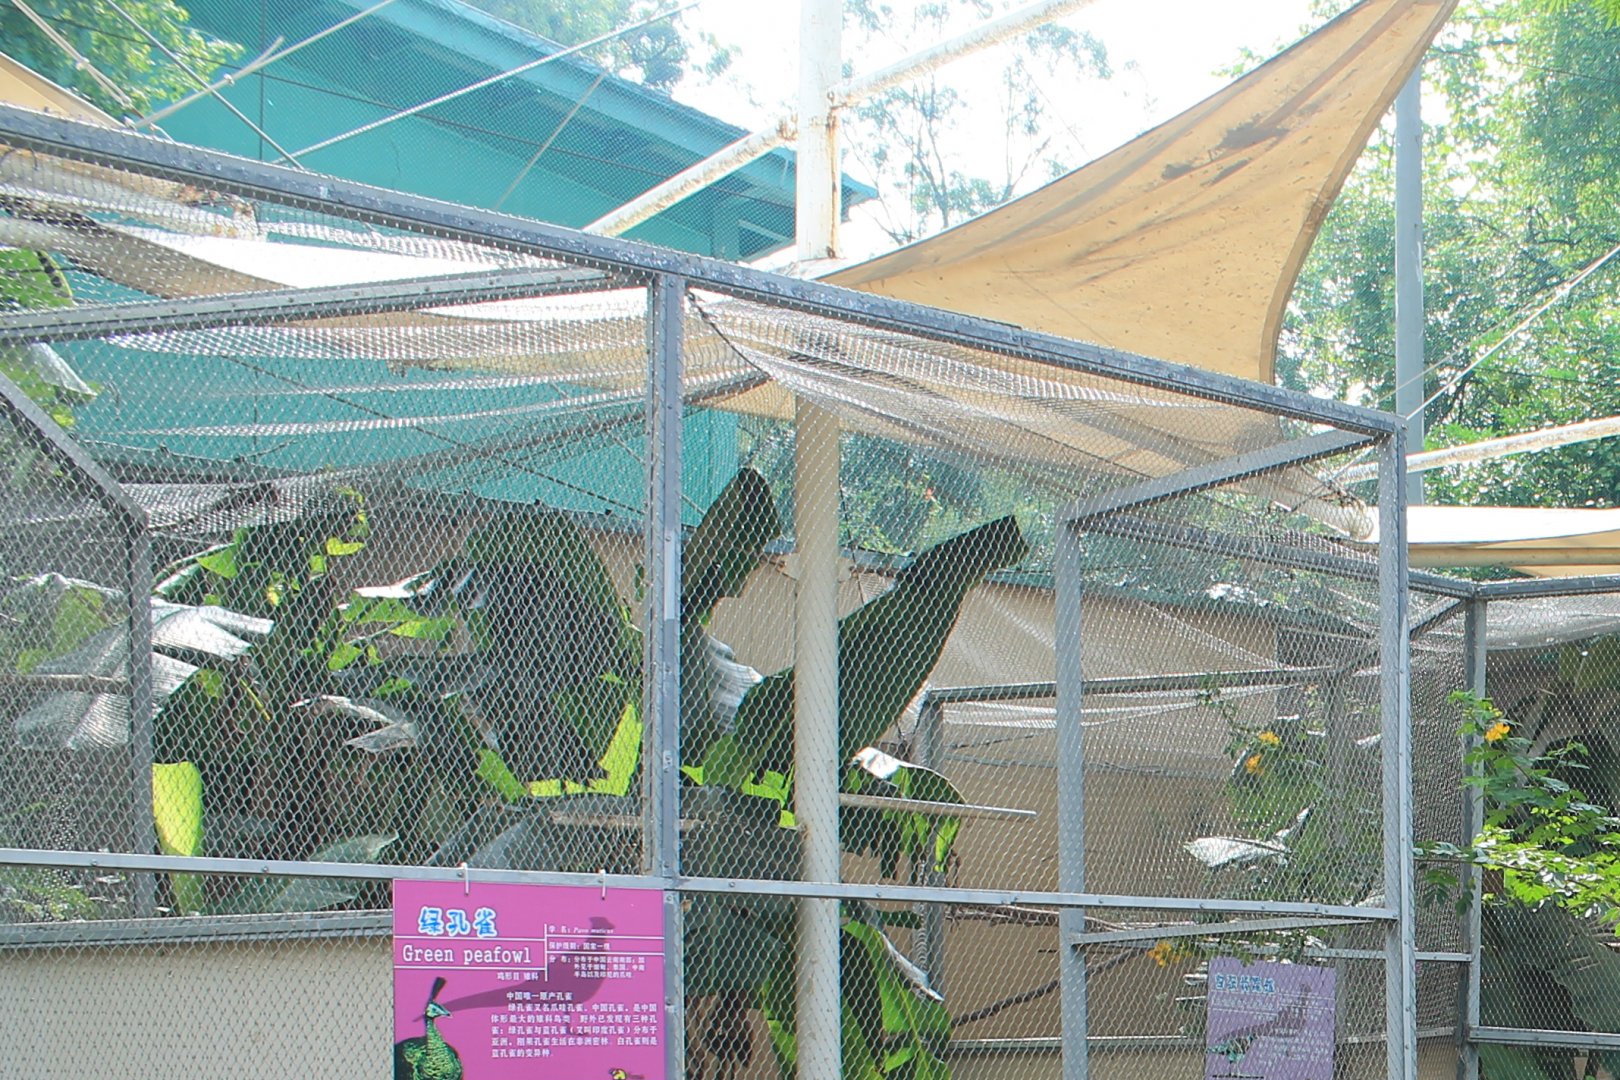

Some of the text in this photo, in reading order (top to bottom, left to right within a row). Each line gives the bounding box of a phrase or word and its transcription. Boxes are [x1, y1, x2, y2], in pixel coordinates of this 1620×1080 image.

[418, 907, 497, 938] 绿孔雀
[402, 944, 531, 965] Green peafowl
